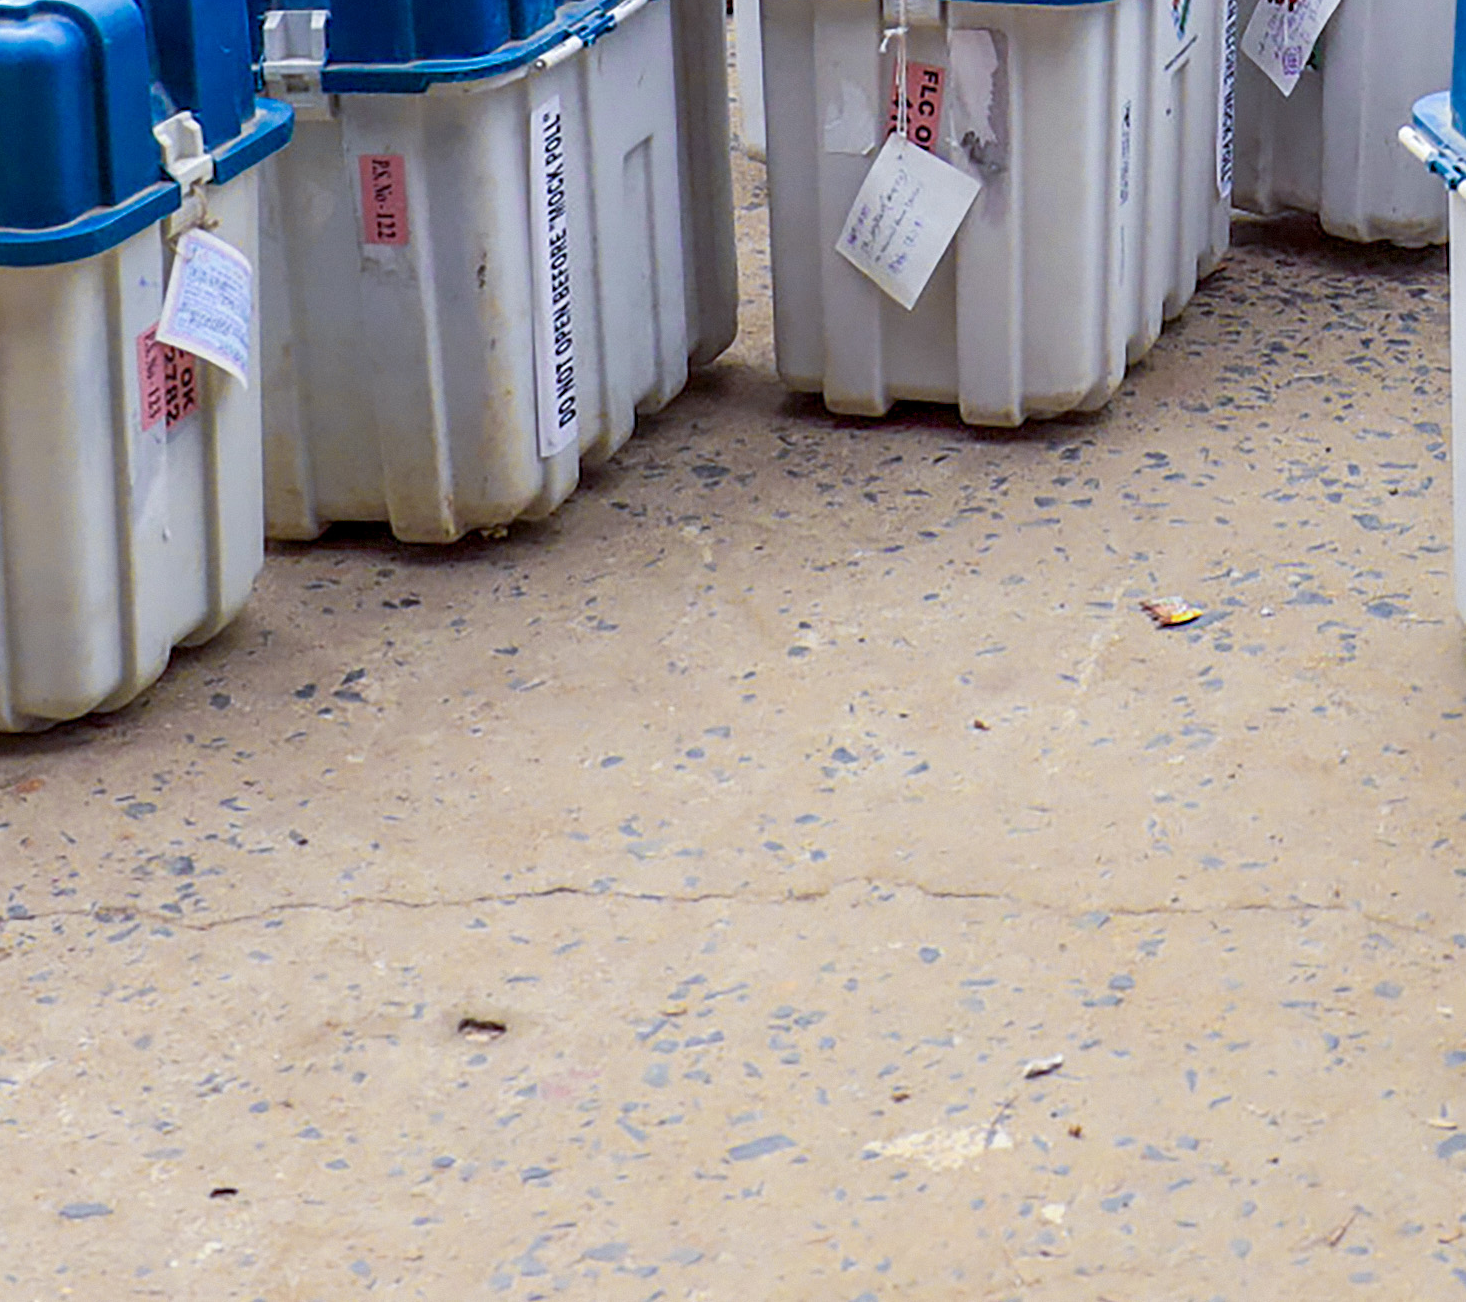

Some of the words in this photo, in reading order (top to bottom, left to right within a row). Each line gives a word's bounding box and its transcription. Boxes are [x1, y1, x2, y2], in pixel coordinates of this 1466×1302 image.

[918, 69, 939, 117] FLC
[542, 112, 563, 167] POLL"
[915, 124, 932, 151] O
[546, 163, 566, 232] "MOCK
[376, 213, 396, 239] 122
[549, 227, 571, 306] BEFORE
[552, 300, 573, 357] OPEN
[180, 368, 195, 411] OK
[556, 356, 576, 399] NOT
[559, 396, 577, 429] DO
